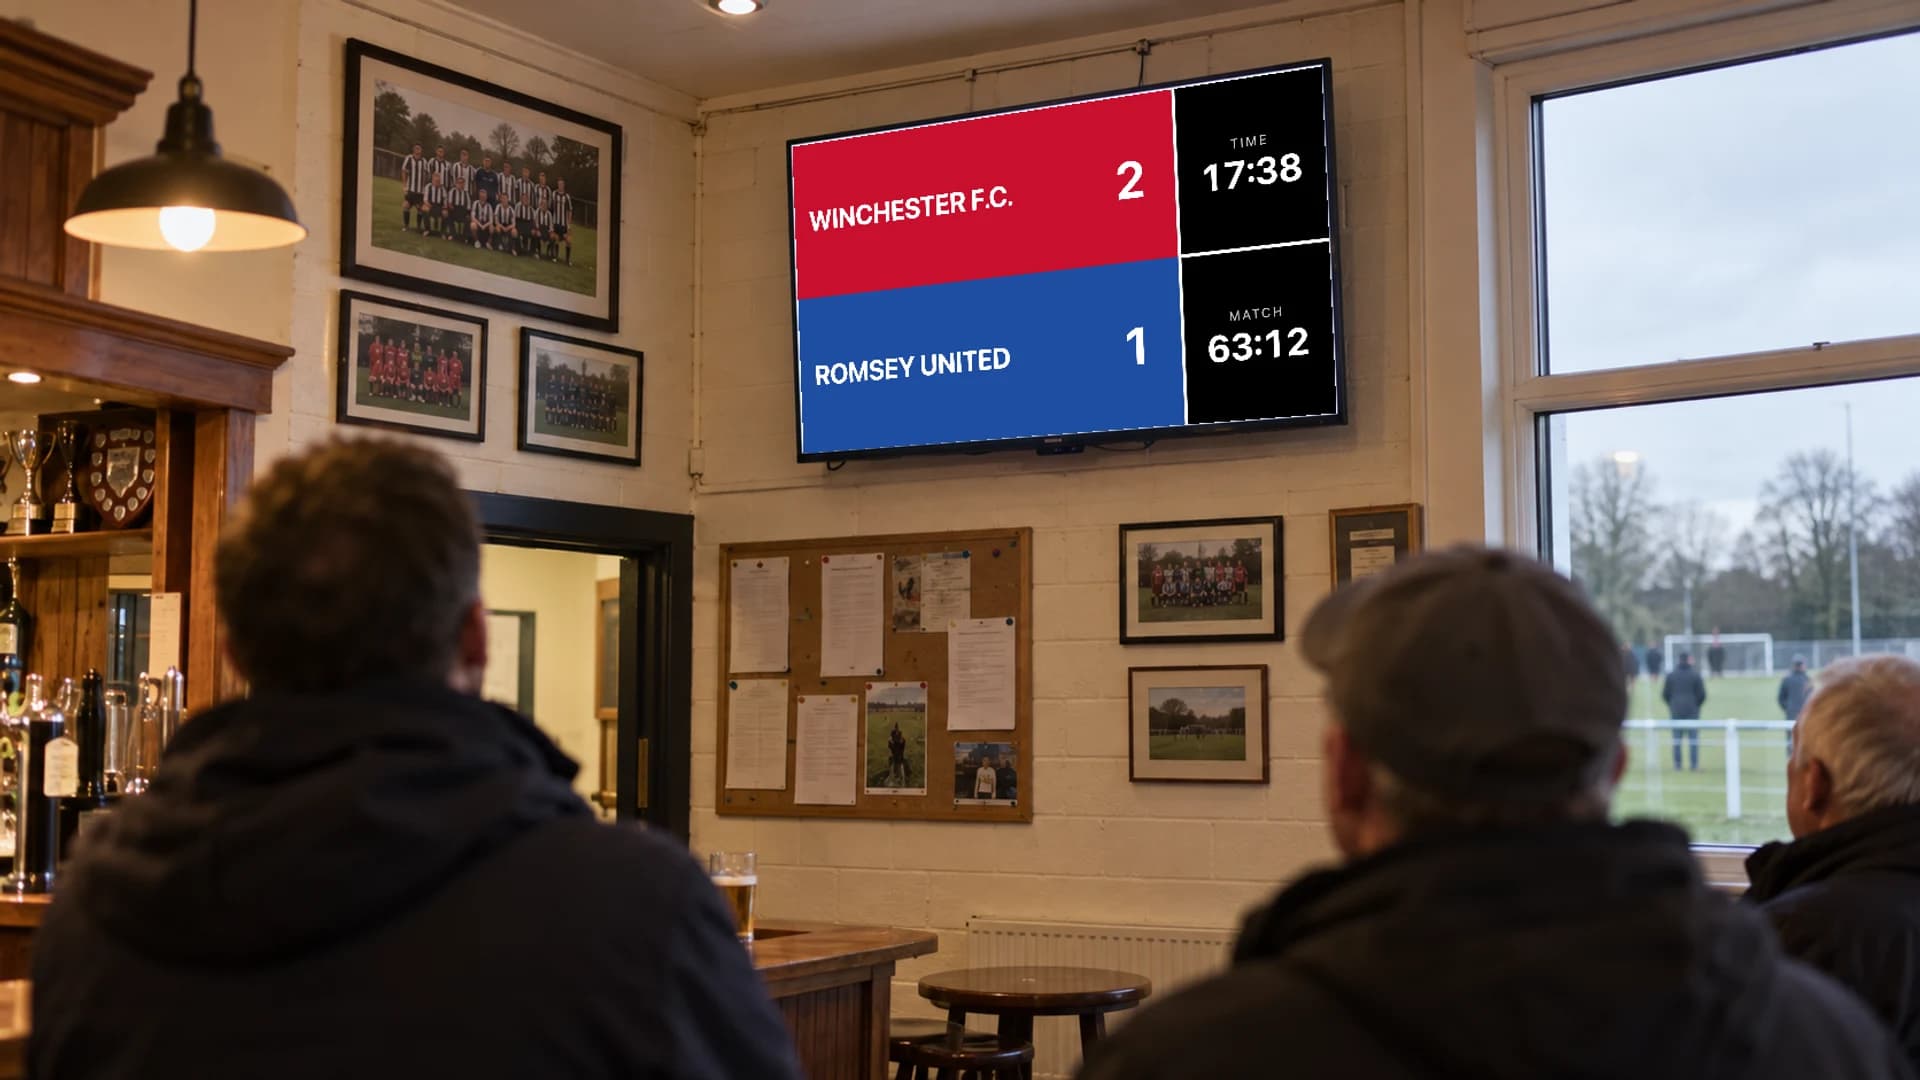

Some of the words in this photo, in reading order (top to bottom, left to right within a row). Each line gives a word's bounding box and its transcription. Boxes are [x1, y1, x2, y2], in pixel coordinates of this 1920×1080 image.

[1230, 134, 1267, 149] TIME
[1116, 160, 1145, 201] 2
[1203, 152, 1303, 192] 17:38
[808, 191, 966, 232] WINCHESTER
[971, 185, 1014, 211] F.C.
[1229, 306, 1283, 322] MATCH
[1126, 326, 1145, 365] 1
[1208, 327, 1310, 363] 63:12
[815, 355, 915, 386] ROMSEY
[920, 347, 1011, 377] UNITED
